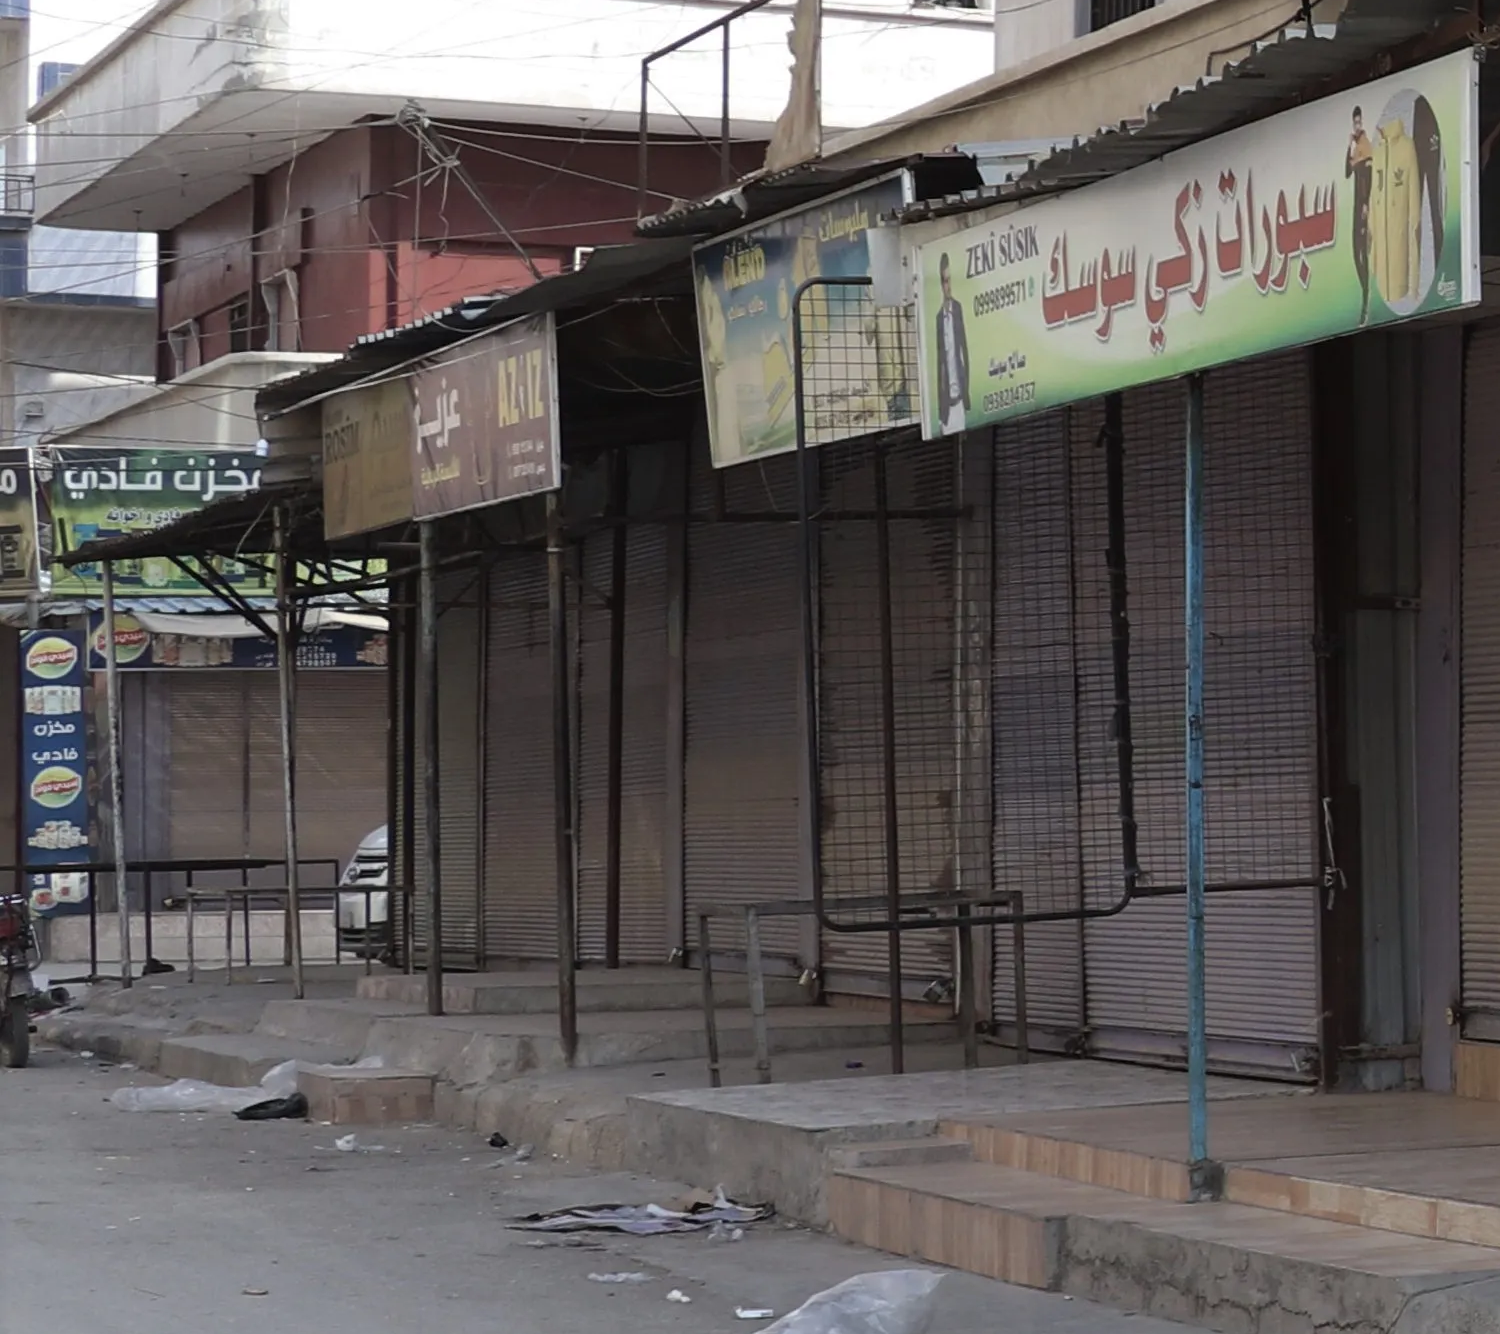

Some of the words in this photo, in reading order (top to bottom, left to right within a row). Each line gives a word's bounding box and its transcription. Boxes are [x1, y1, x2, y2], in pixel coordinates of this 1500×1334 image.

[966, 231, 996, 280] ZEKÎ
[999, 224, 1039, 267] SÛSIK
[1216, 169, 1336, 293] سبورات
[1042, 231, 1136, 341] سوسك
[1146, 179, 1208, 352] زكي
[413, 376, 461, 455] عزيز
[63, 457, 163, 500] فادي
[32, 746, 79, 763] فادي
[33, 720, 76, 737] مخزن
